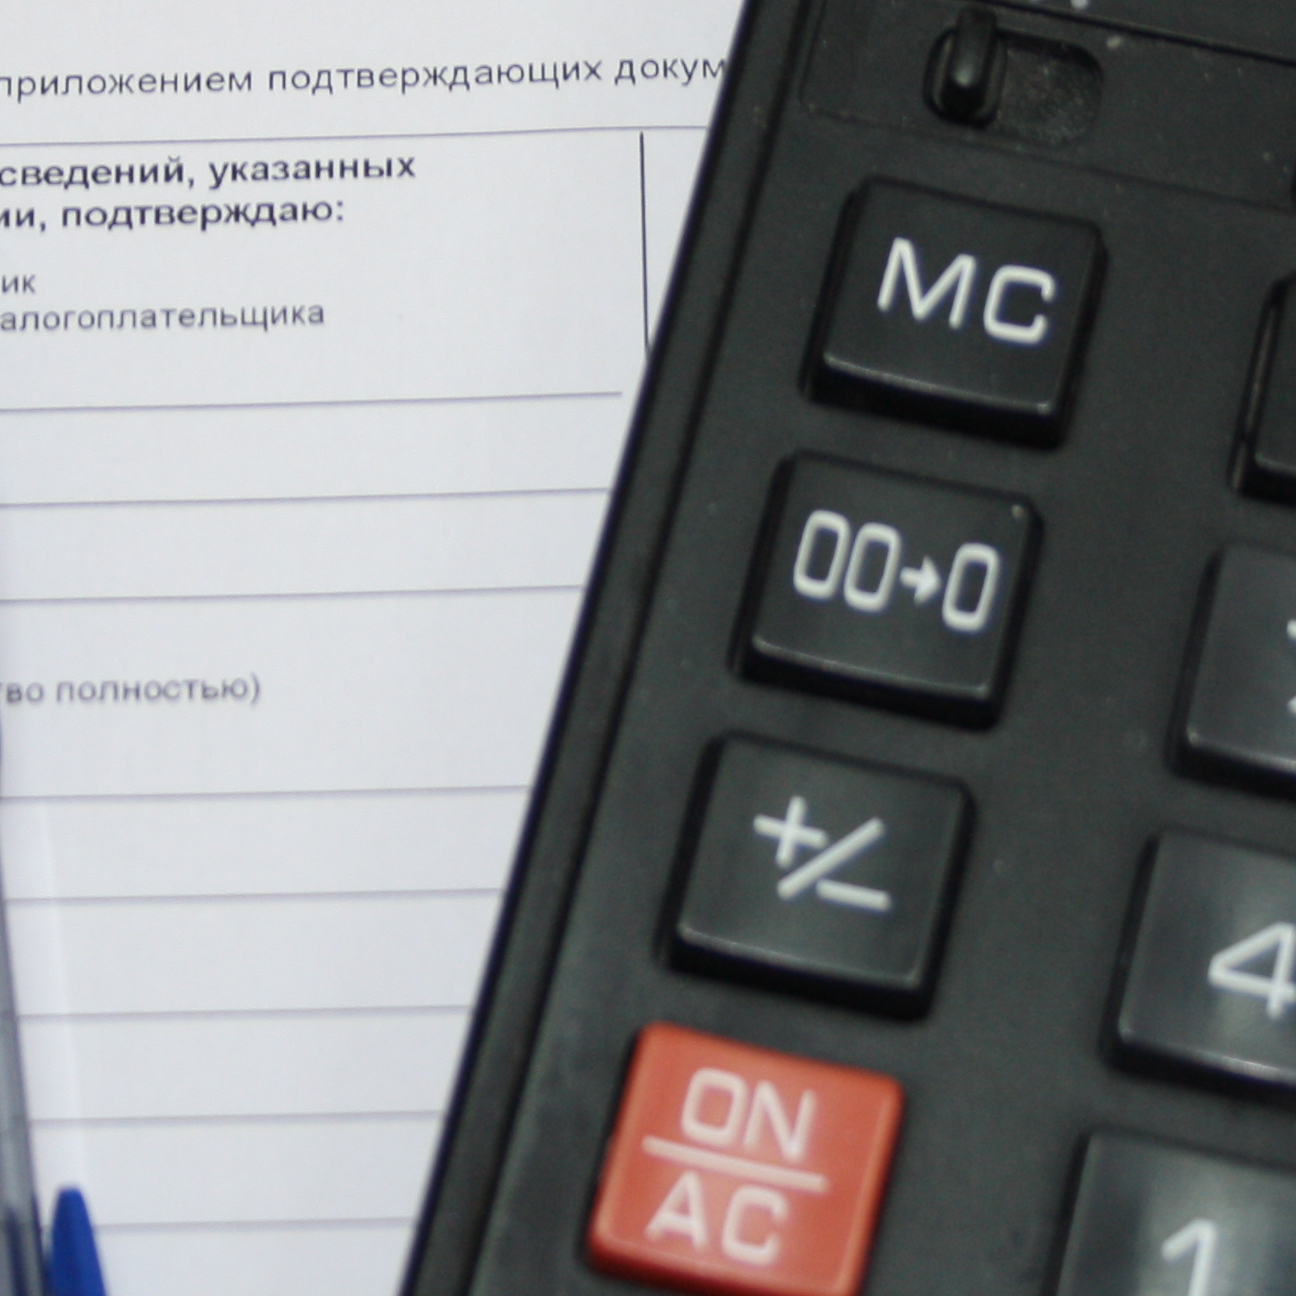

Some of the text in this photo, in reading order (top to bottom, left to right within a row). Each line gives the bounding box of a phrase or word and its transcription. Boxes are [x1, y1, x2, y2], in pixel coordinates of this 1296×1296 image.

[268, 60, 602, 96] подтверждающих
[208, 157, 415, 191] указанных
[61, 201, 343, 233] подтверждаю:
[876, 236, 1056, 347] MC
[55, 674, 261, 706] полностью)
[679, 1064, 818, 1165] ON
[645, 1172, 792, 1268] AC
